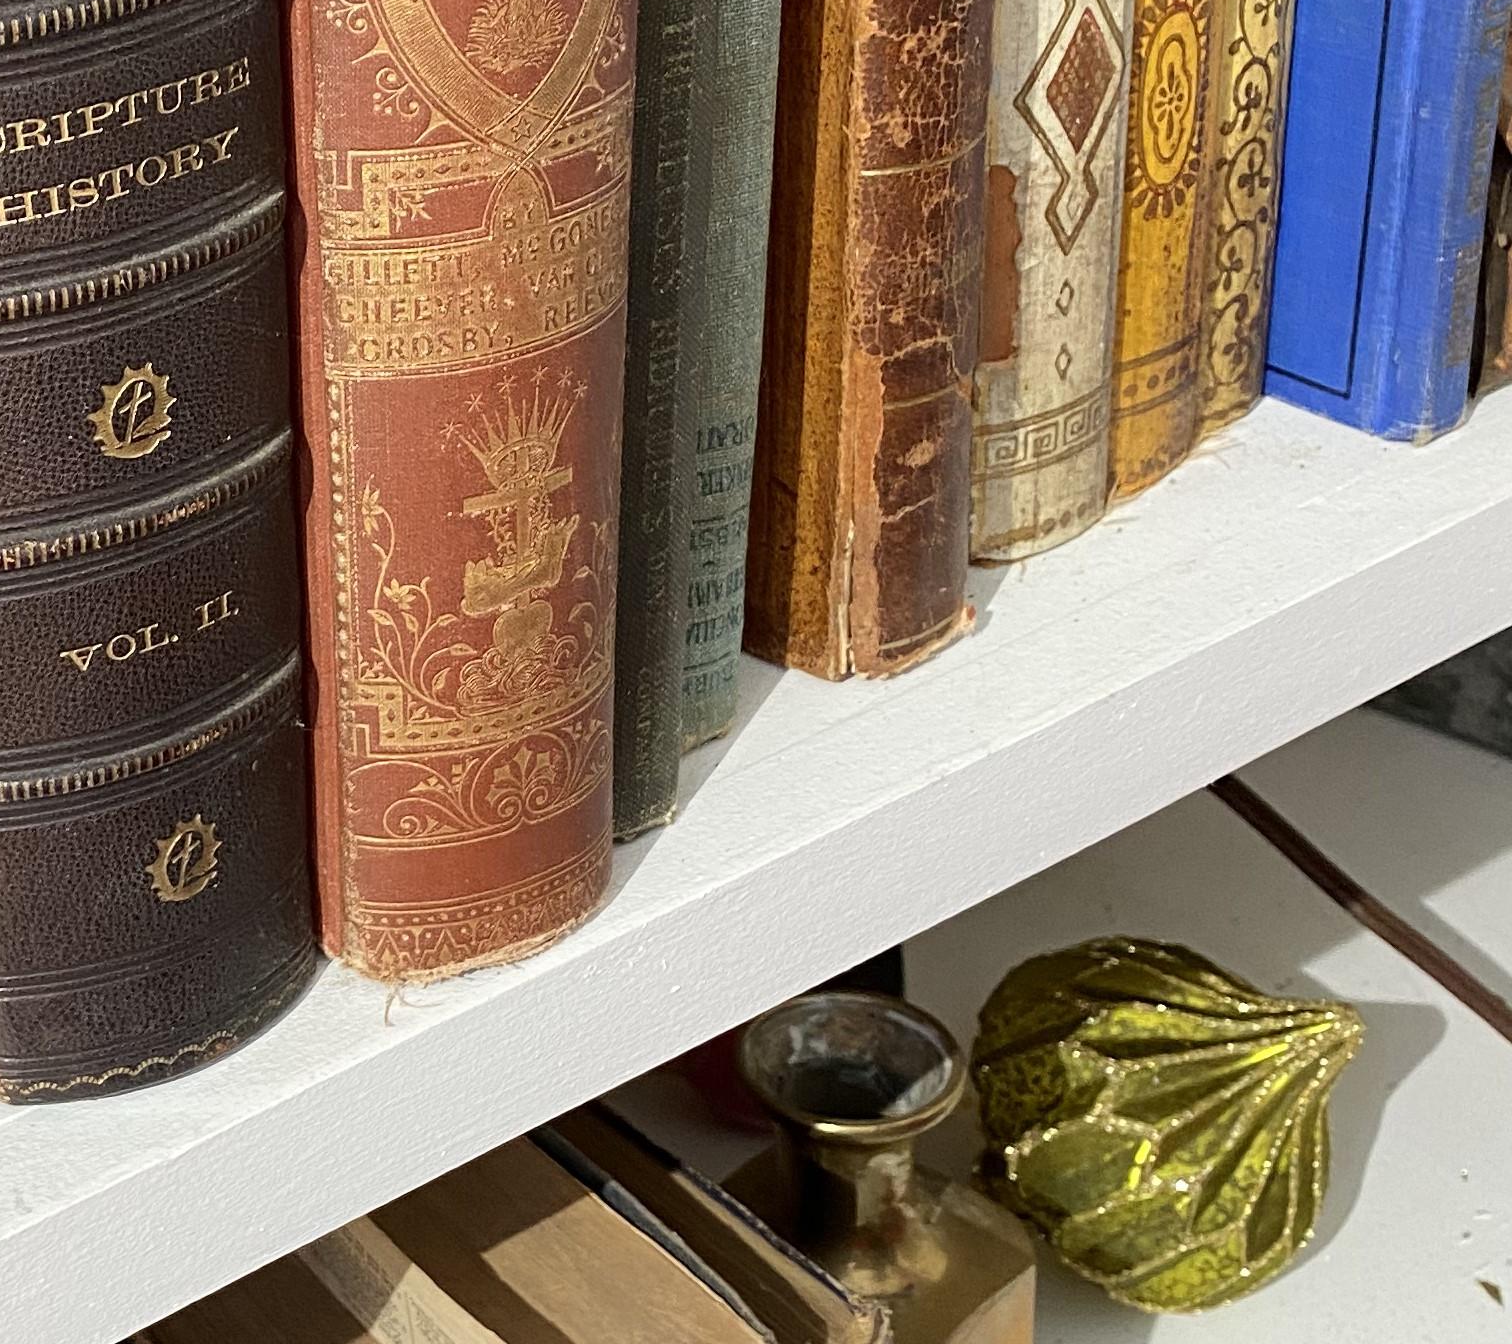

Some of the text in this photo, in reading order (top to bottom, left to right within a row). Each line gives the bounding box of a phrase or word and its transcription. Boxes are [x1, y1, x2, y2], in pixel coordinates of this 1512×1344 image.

[501, 199, 536, 231] BY
[357, 321, 515, 363] CROSBY,
[60, 622, 179, 674] VOL.
